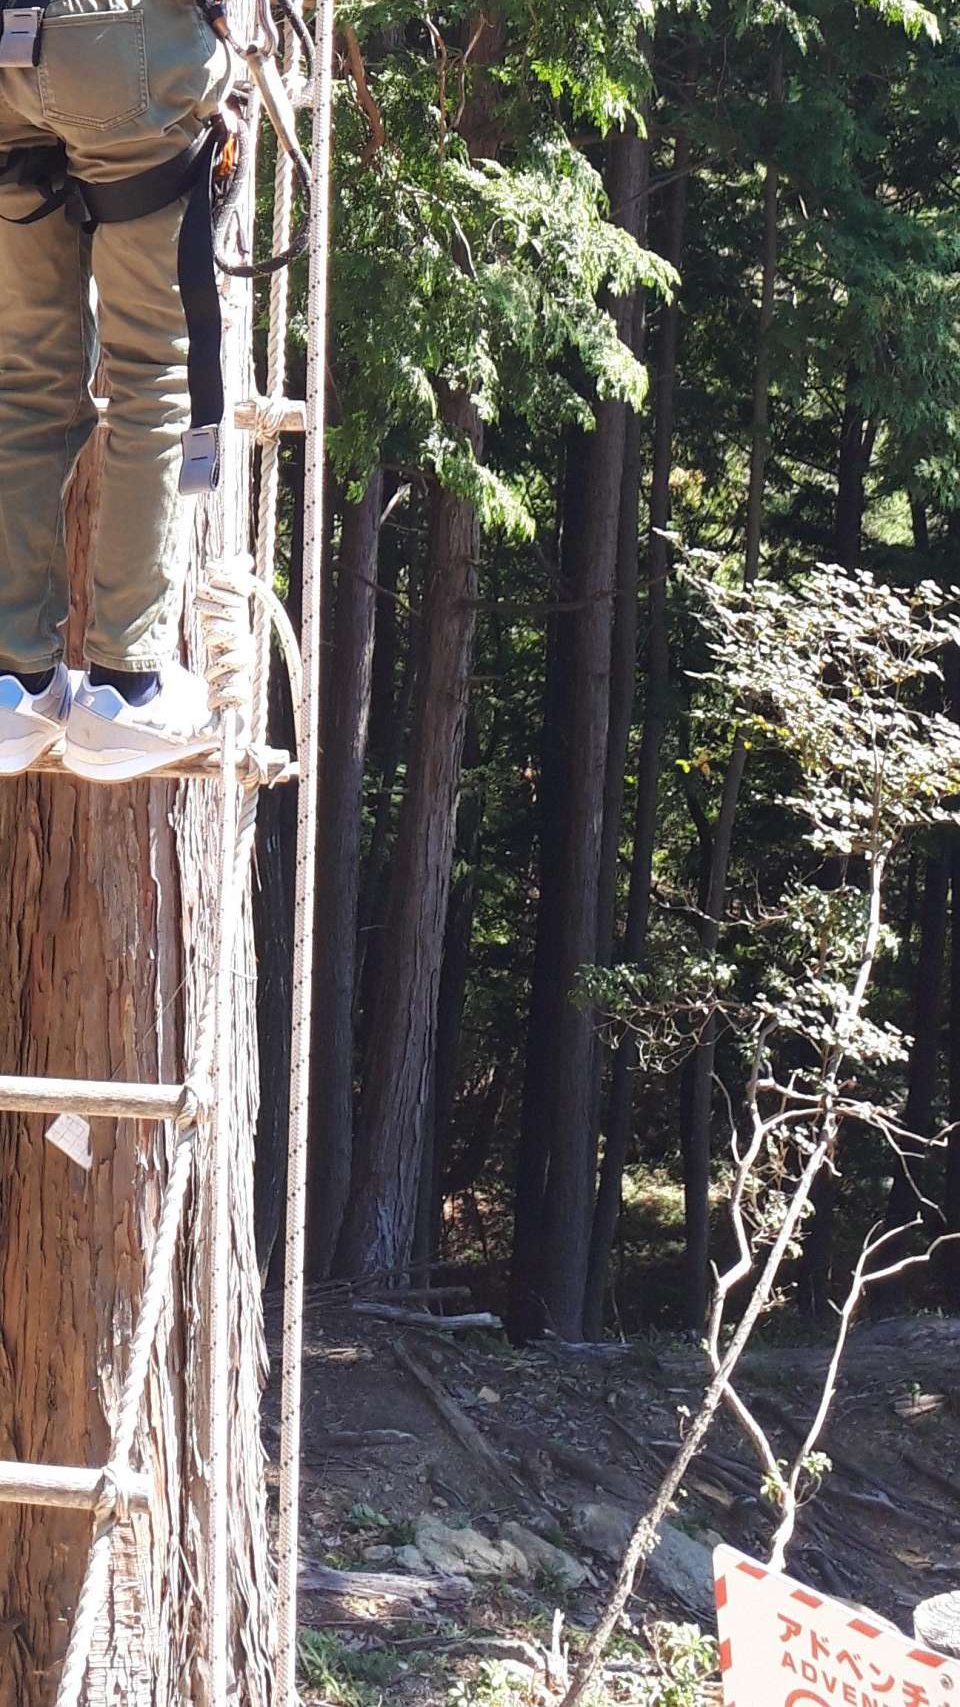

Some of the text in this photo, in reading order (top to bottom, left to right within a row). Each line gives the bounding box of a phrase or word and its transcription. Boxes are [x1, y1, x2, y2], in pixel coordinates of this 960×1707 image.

[777, 1612, 951, 1707] アドベンチ
[781, 1650, 890, 1707] ADVEN
